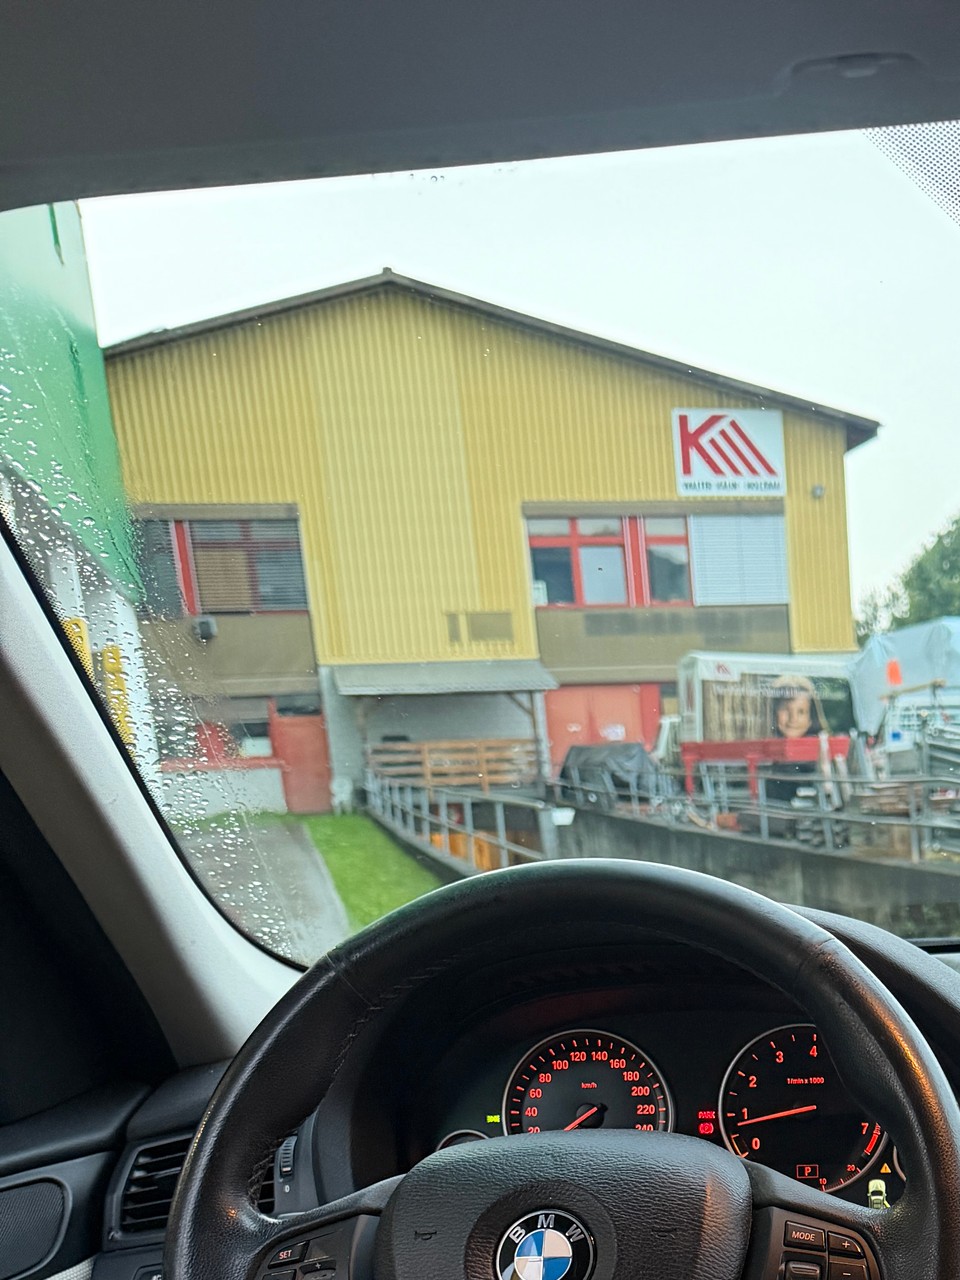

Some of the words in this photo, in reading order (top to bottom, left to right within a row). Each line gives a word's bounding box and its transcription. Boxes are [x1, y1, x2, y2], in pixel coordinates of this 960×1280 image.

[591, 1051, 608, 1061] 140
[810, 1046, 818, 1057] 4
[570, 1052, 586, 1062] 120
[776, 1051, 784, 1063] 3
[552, 1060, 569, 1070] 100
[609, 1059, 626, 1069] 160
[539, 1073, 552, 1083] 80
[622, 1072, 640, 1082] 180
[749, 1076, 757, 1087] 2
[529, 1088, 542, 1099] 60
[631, 1086, 650, 1096] 200
[525, 1107, 538, 1117] 40
[637, 1105, 656, 1115] 220
[698, 1111, 716, 1119] PARK
[742, 1108, 748, 1120] 1
[861, 1123, 869, 1134] 7
[752, 1138, 760, 1150] 0
[804, 1167, 812, 1176] P
[847, 1164, 855, 1172] 20
[509, 1214, 585, 1244] BMW
[791, 1231, 816, 1241] MODE
[279, 1249, 292, 1260] SET
